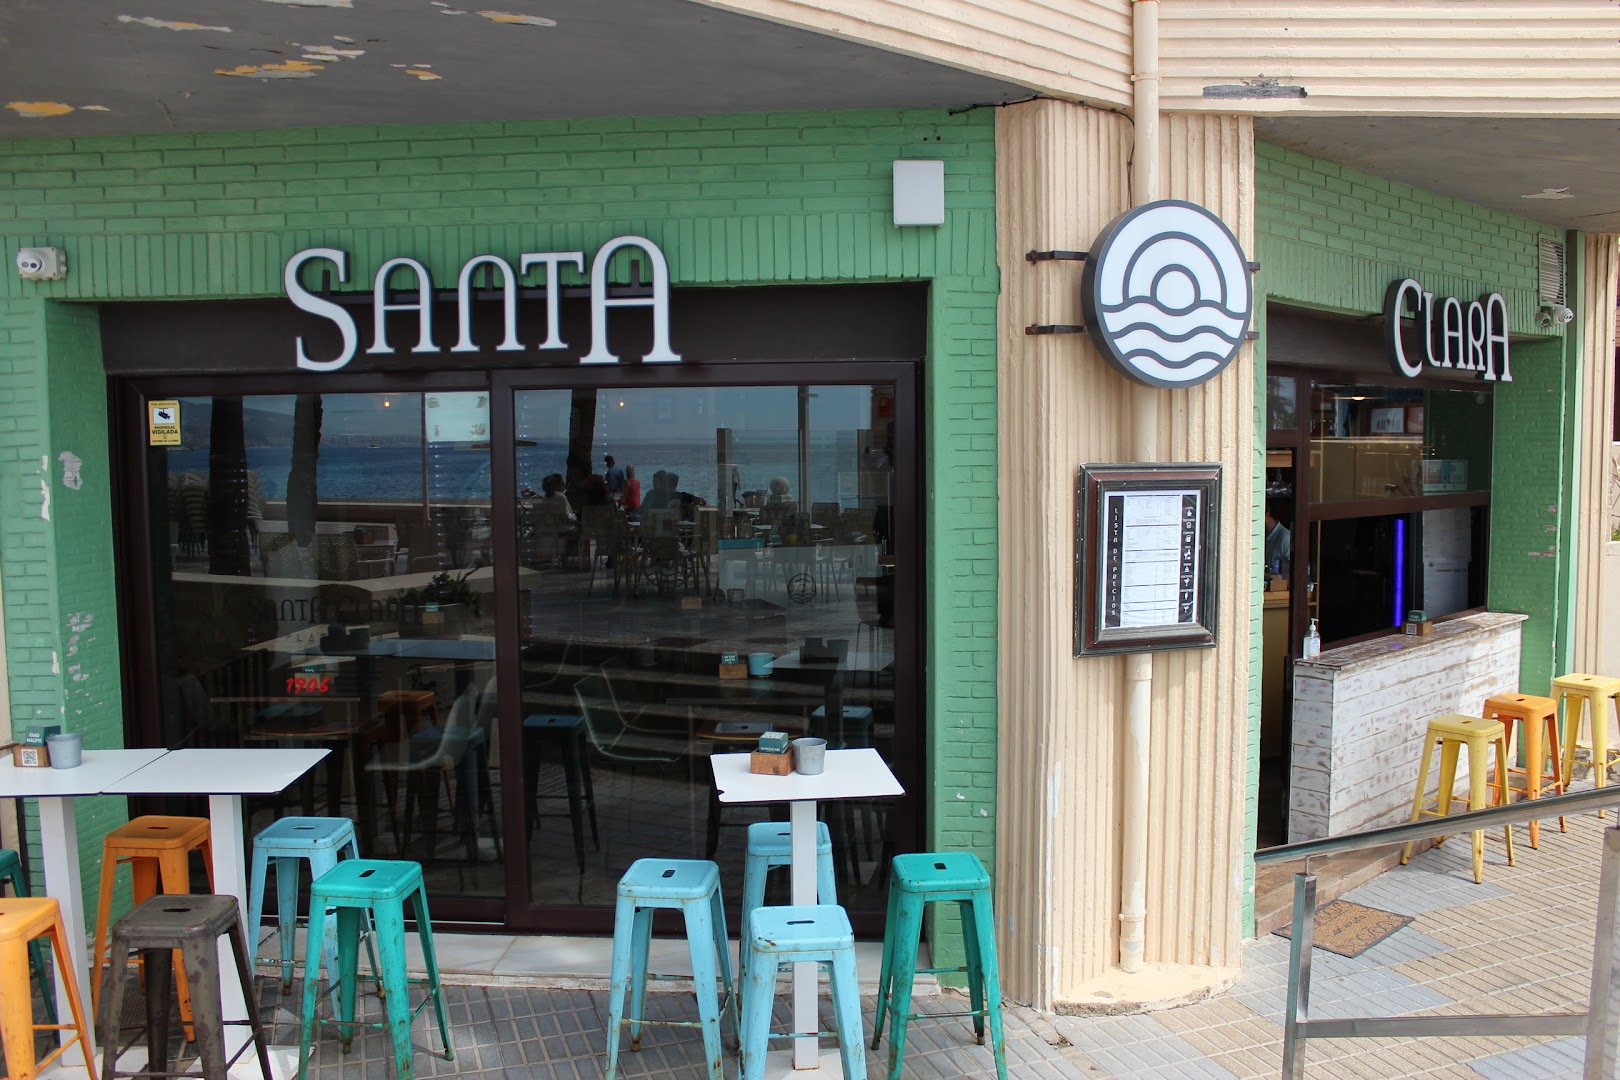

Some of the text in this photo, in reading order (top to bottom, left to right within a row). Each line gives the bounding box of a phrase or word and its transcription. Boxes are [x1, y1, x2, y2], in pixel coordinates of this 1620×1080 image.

[284, 235, 682, 372] SANTA
[1392, 278, 1512, 382] CLARA
[286, 675, 331, 695] 1906
